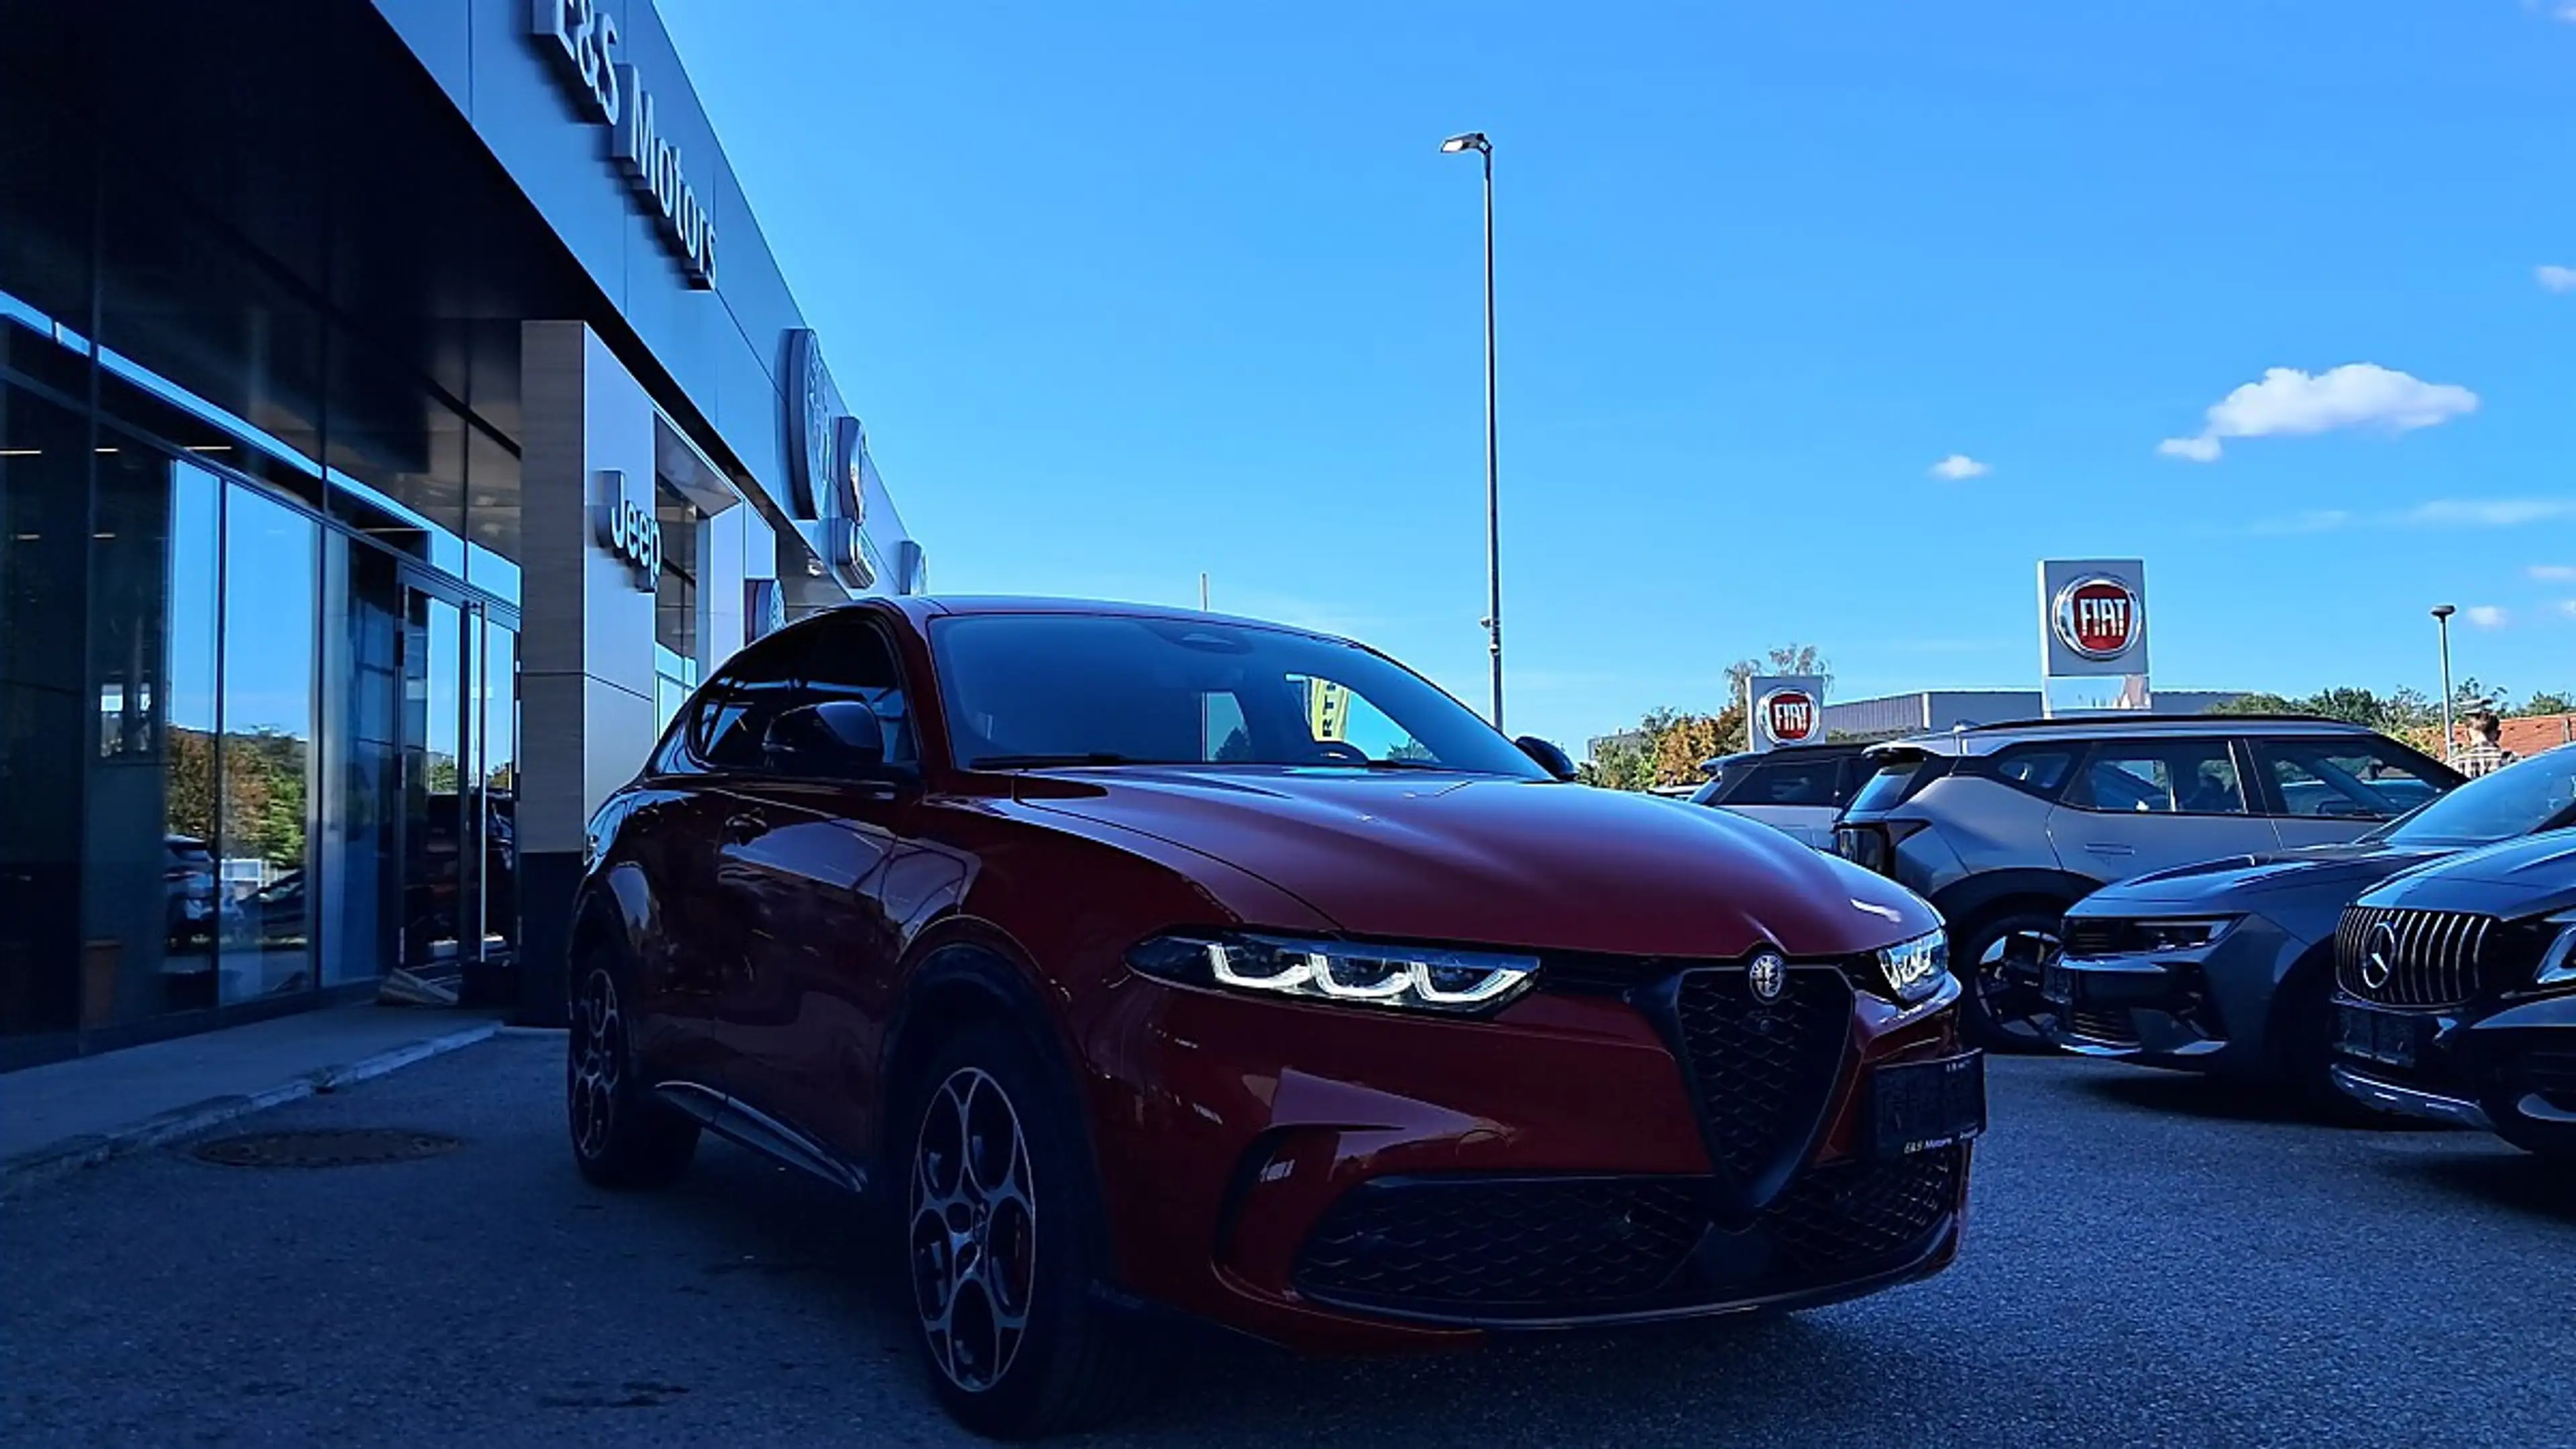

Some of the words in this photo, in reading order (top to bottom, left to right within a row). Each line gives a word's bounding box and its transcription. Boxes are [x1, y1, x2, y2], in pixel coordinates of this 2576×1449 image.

[631, 64, 716, 291] Motors
[611, 472, 662, 589] Jeep
[2080, 598, 2126, 637] FIAT
[1774, 702, 1808, 731] FIAT
